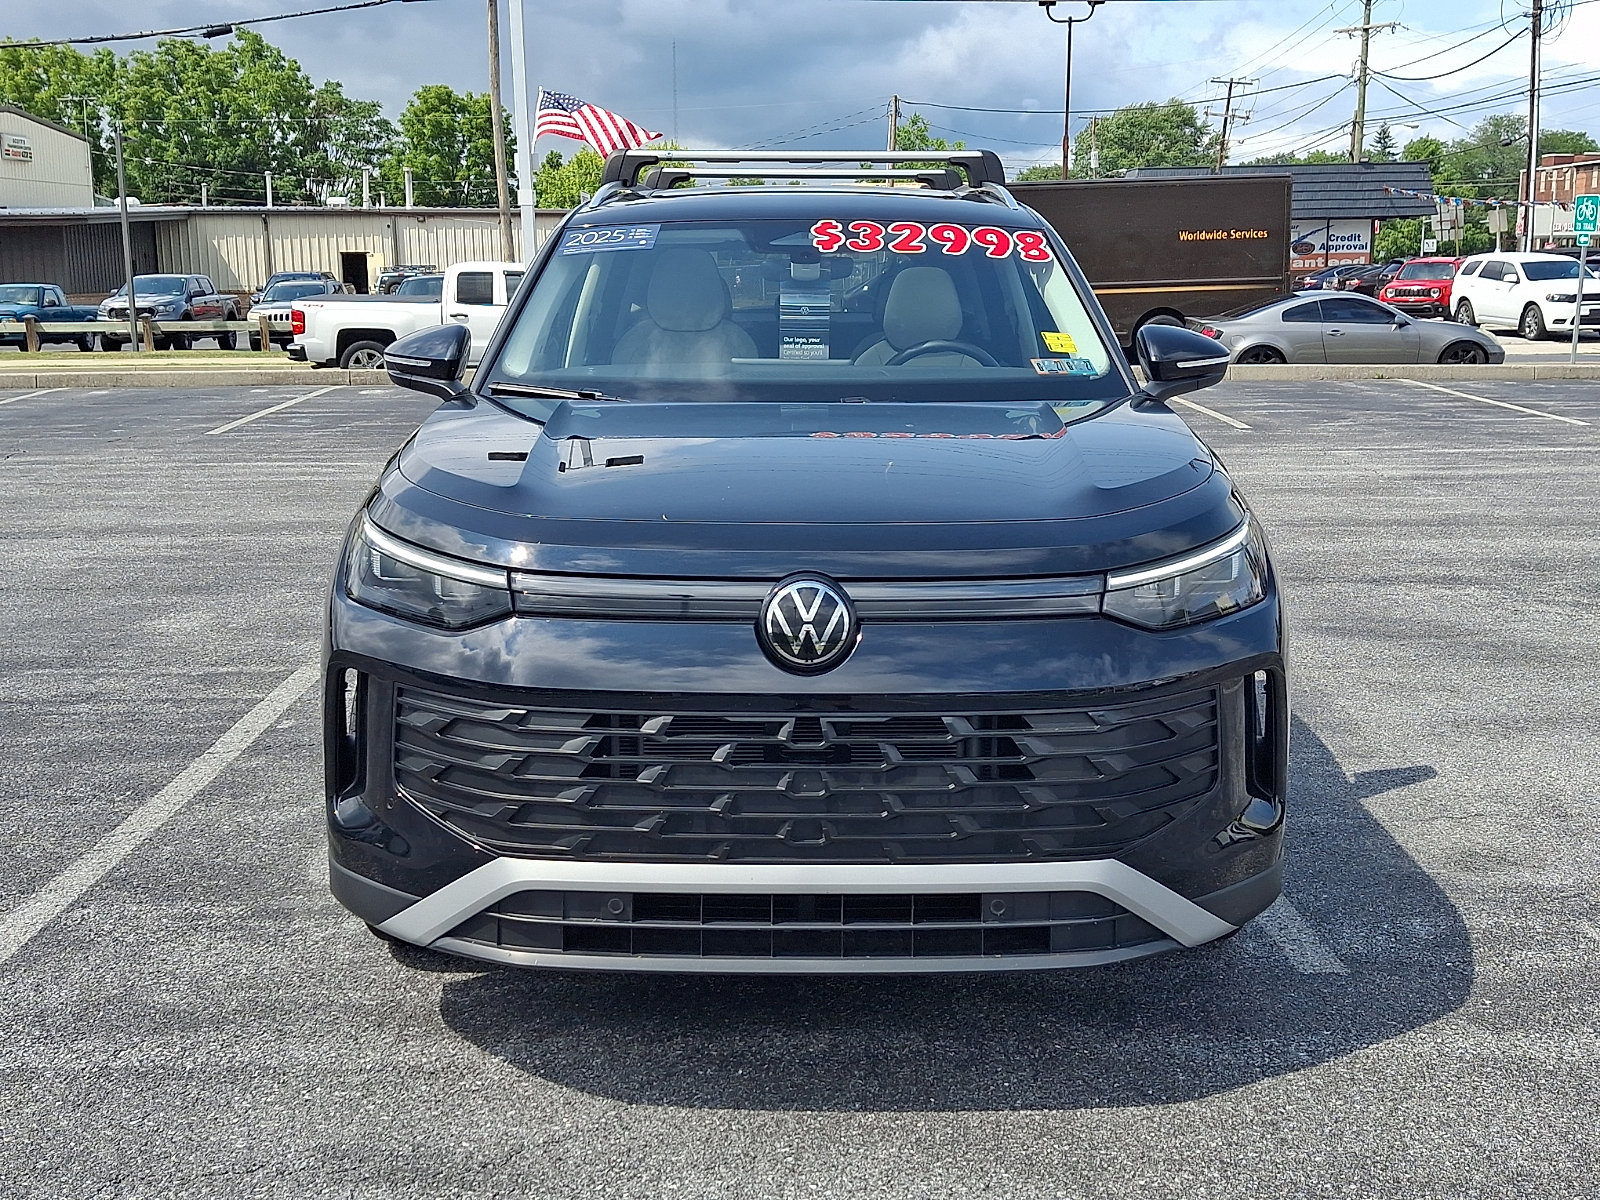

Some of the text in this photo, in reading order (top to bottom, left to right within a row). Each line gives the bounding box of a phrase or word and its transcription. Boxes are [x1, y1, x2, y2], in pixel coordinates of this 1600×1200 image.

[566, 229, 627, 246] 2025
[1179, 228, 1268, 241] Worldwide Services
[1329, 233, 1362, 242] Credit
[810, 219, 1053, 262] $32998
[1318, 242, 1368, 252] Approval
[794, 336, 808, 344] logo,
